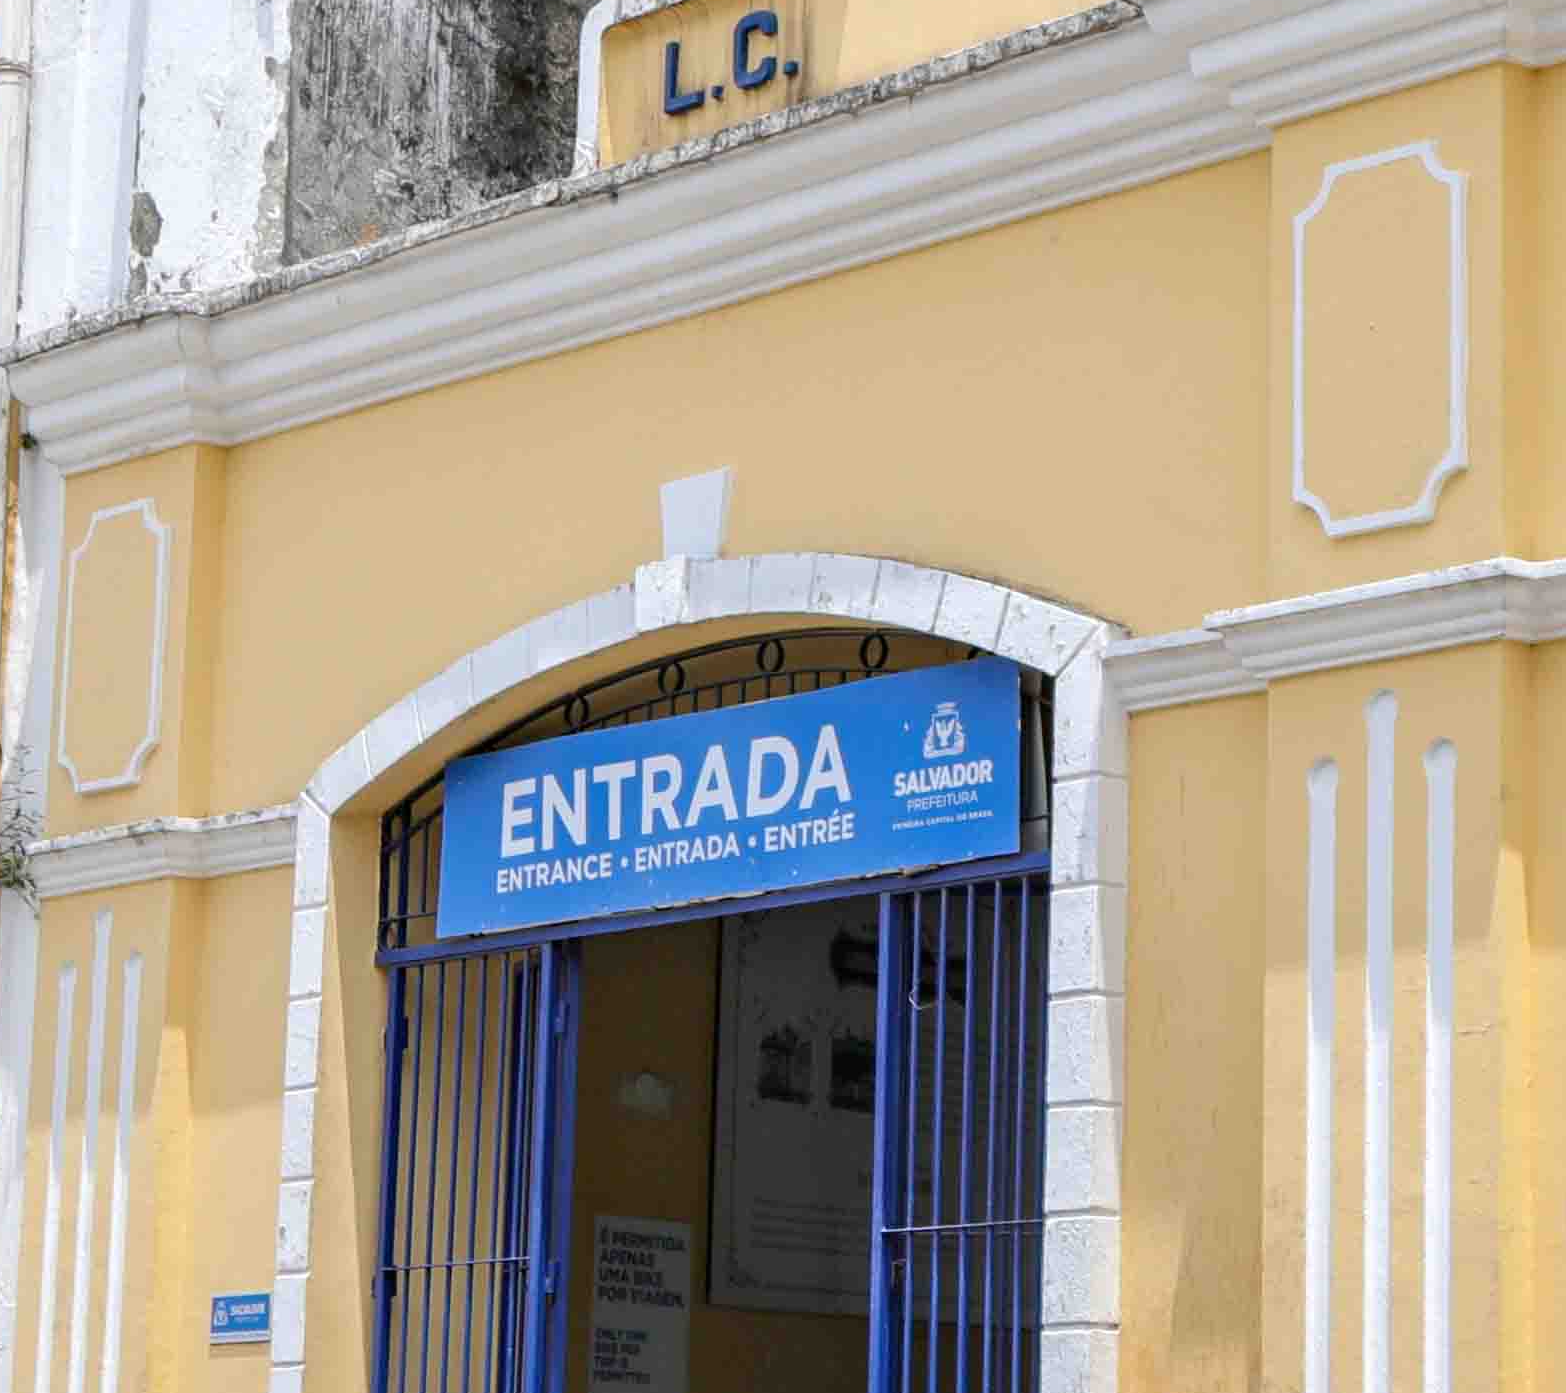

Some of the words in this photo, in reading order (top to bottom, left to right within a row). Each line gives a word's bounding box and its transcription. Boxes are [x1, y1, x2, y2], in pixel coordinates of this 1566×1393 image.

[664, 10, 799, 115] L.C.
[500, 723, 853, 858] ENTRADA
[894, 759, 994, 797] SALVADOR
[906, 790, 979, 814] PREFEITURA
[496, 852, 613, 894] ENTRANCE
[634, 832, 741, 873] ENTRADA
[763, 808, 856, 853] ENTRÉE
